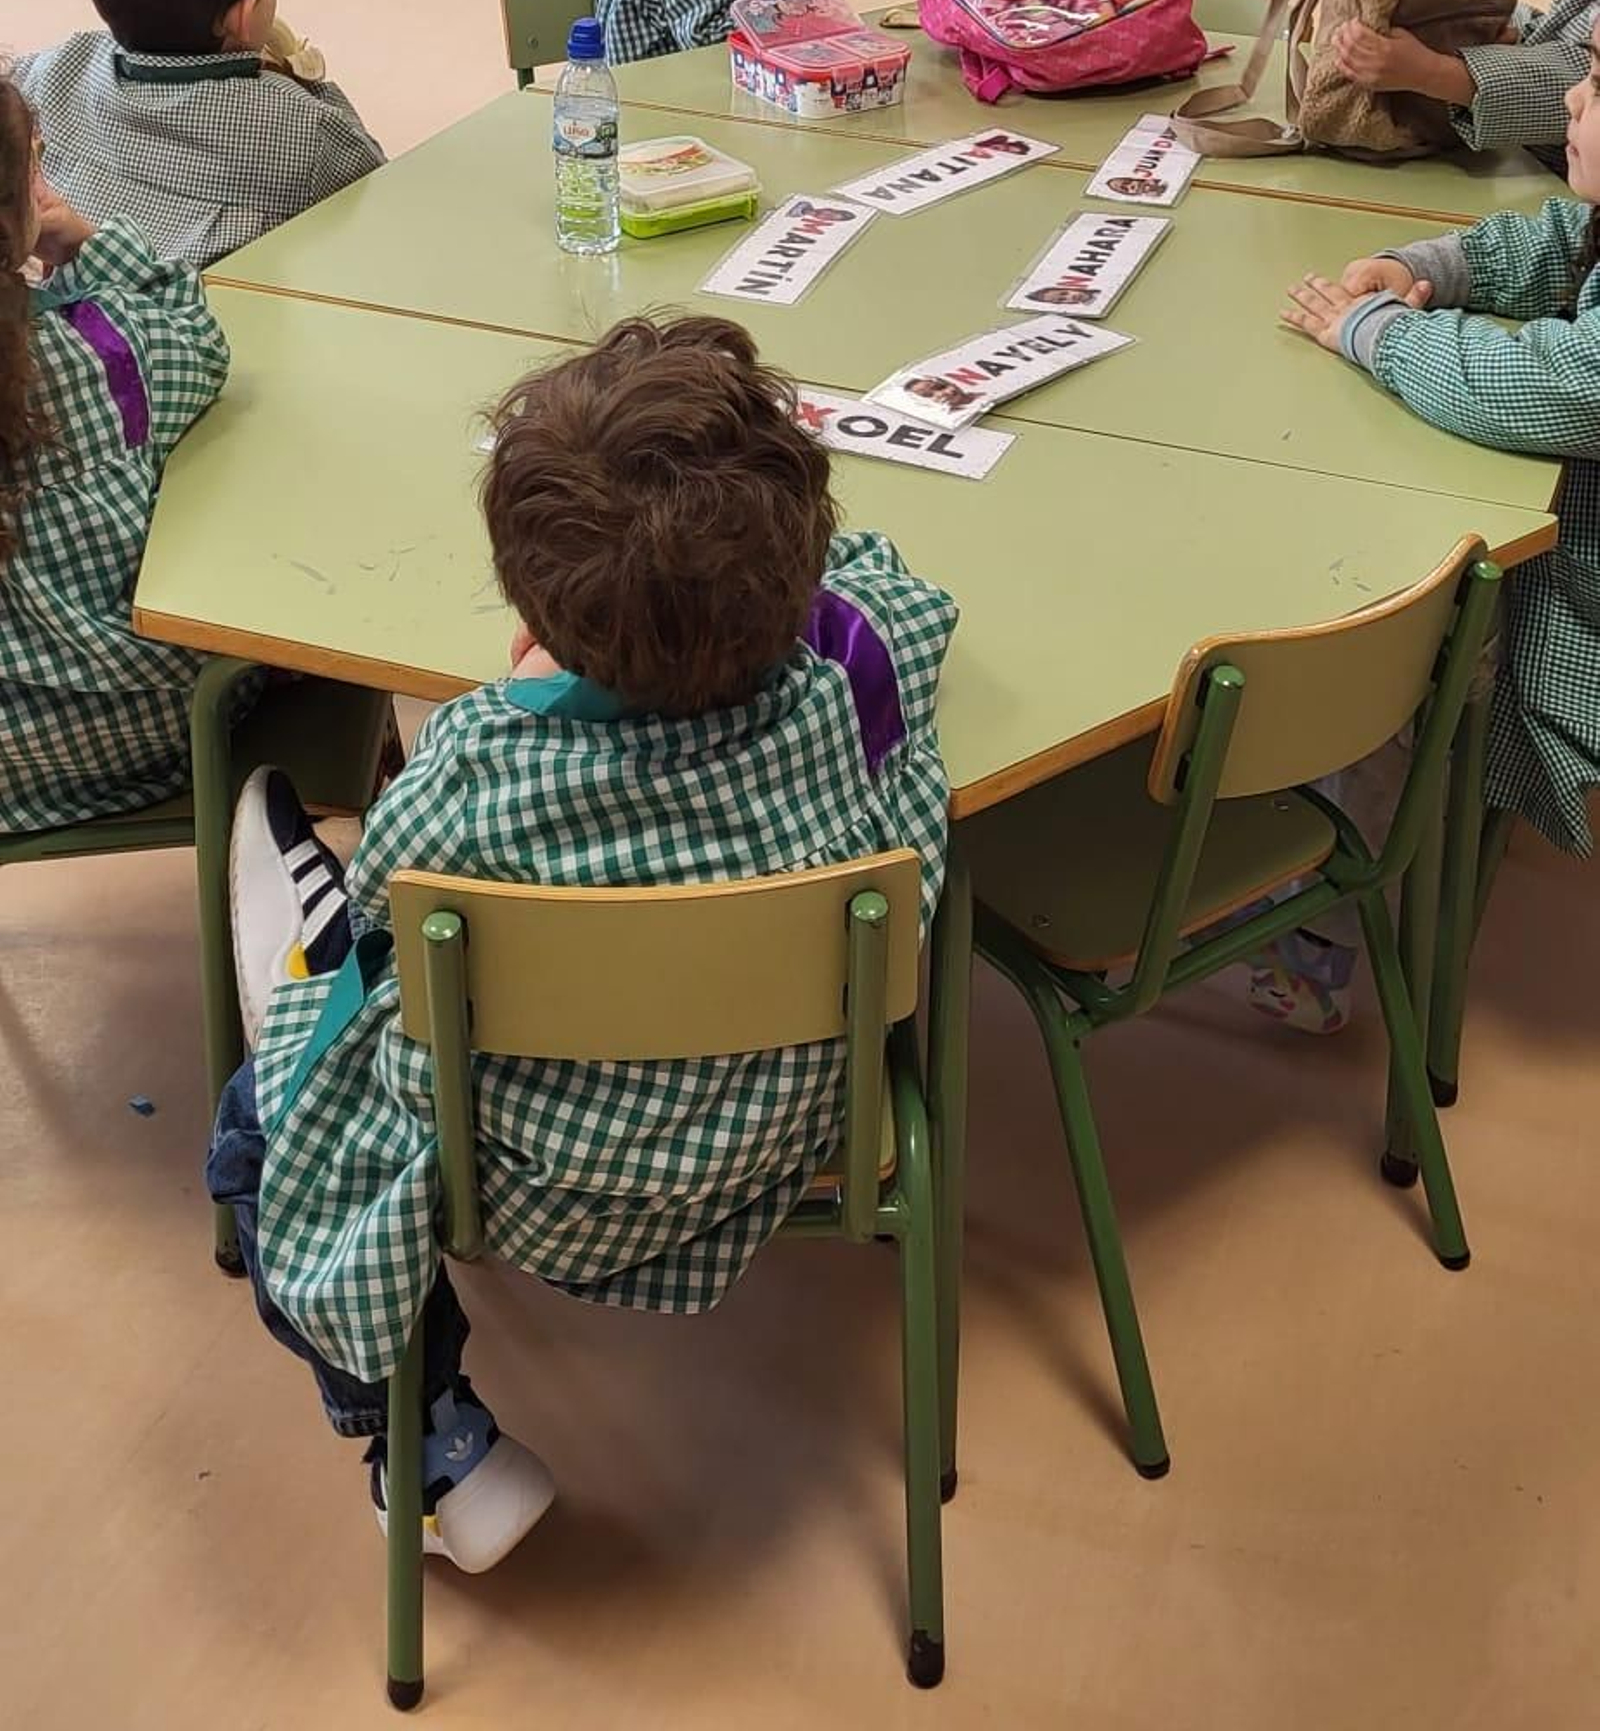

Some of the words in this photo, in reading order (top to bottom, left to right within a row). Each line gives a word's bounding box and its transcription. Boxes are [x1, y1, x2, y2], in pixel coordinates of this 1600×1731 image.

[861, 147, 994, 201] AITANA
[734, 217, 834, 295] MARTÍN
[1056, 218, 1140, 289] NAHARA
[945, 322, 1094, 387] NAYELY
[797, 400, 965, 460] XOEL
